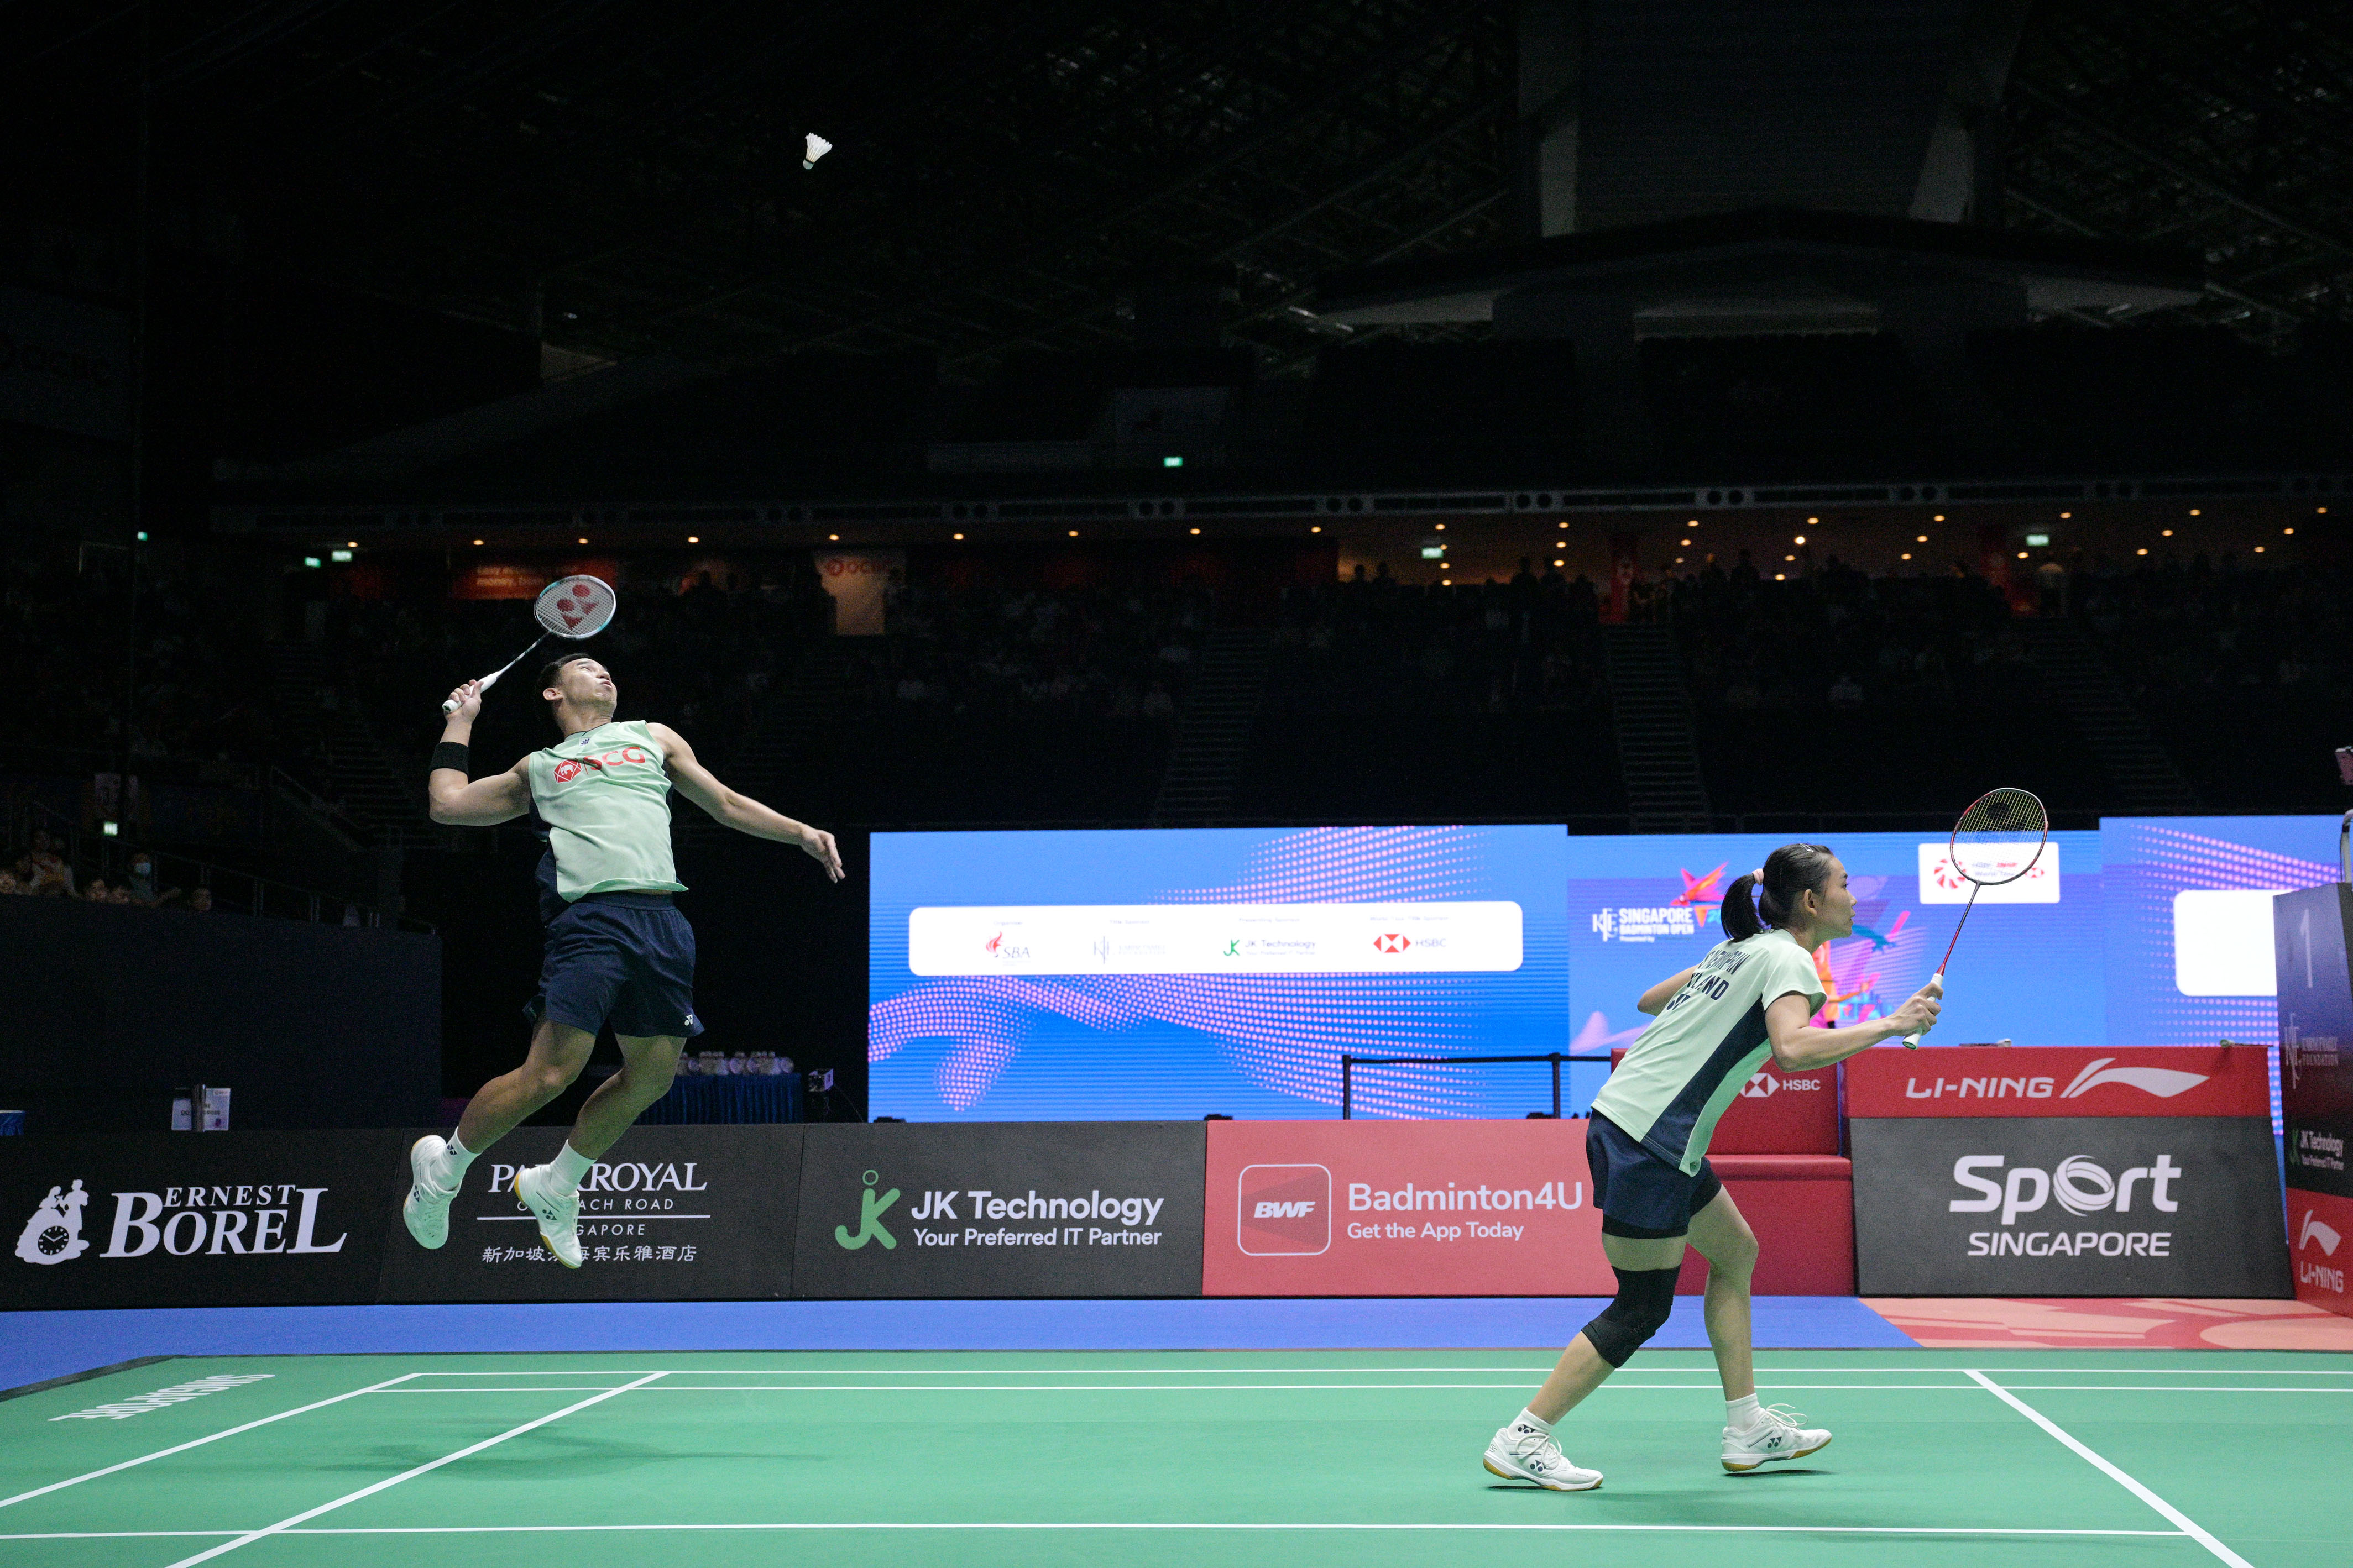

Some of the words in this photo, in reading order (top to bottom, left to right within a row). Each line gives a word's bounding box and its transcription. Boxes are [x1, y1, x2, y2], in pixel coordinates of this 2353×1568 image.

[1618, 908, 1693, 924] SINGAPORE
[1619, 924, 1670, 935] BADMINTON
[1670, 924, 1695, 934] OPEN
[1245, 940, 1257, 948] JK
[1261, 939, 1316, 950] Technology
[1415, 938, 1447, 948] HSBC
[1002, 946, 1031, 959] SBA
[1782, 1079, 1821, 1092] HSBC
[1906, 1077, 2054, 1099] LI-NING
[164, 1184, 296, 1207] ERNEST
[625, 1198, 673, 1210] ROAD
[1348, 1181, 1583, 1211] Badminton4U
[911, 1191, 959, 1220] JK
[968, 1190, 1164, 1226] Technology
[1253, 1201, 1315, 1218] BWF
[100, 1188, 347, 1258] BOREL
[576, 1224, 645, 1236] GAPORE
[1347, 1223, 1381, 1239] Get
[1385, 1222, 1416, 1239] the
[1421, 1222, 1461, 1242] App
[1466, 1221, 1524, 1241] Today
[913, 1228, 958, 1246] Your
[964, 1227, 1057, 1246] Preferred
[1063, 1229, 1084, 1245] IT
[1089, 1229, 1162, 1246] Partner
[1967, 1231, 2172, 1257] SINGAPORE
[2300, 1260, 2344, 1293] LI-NING
